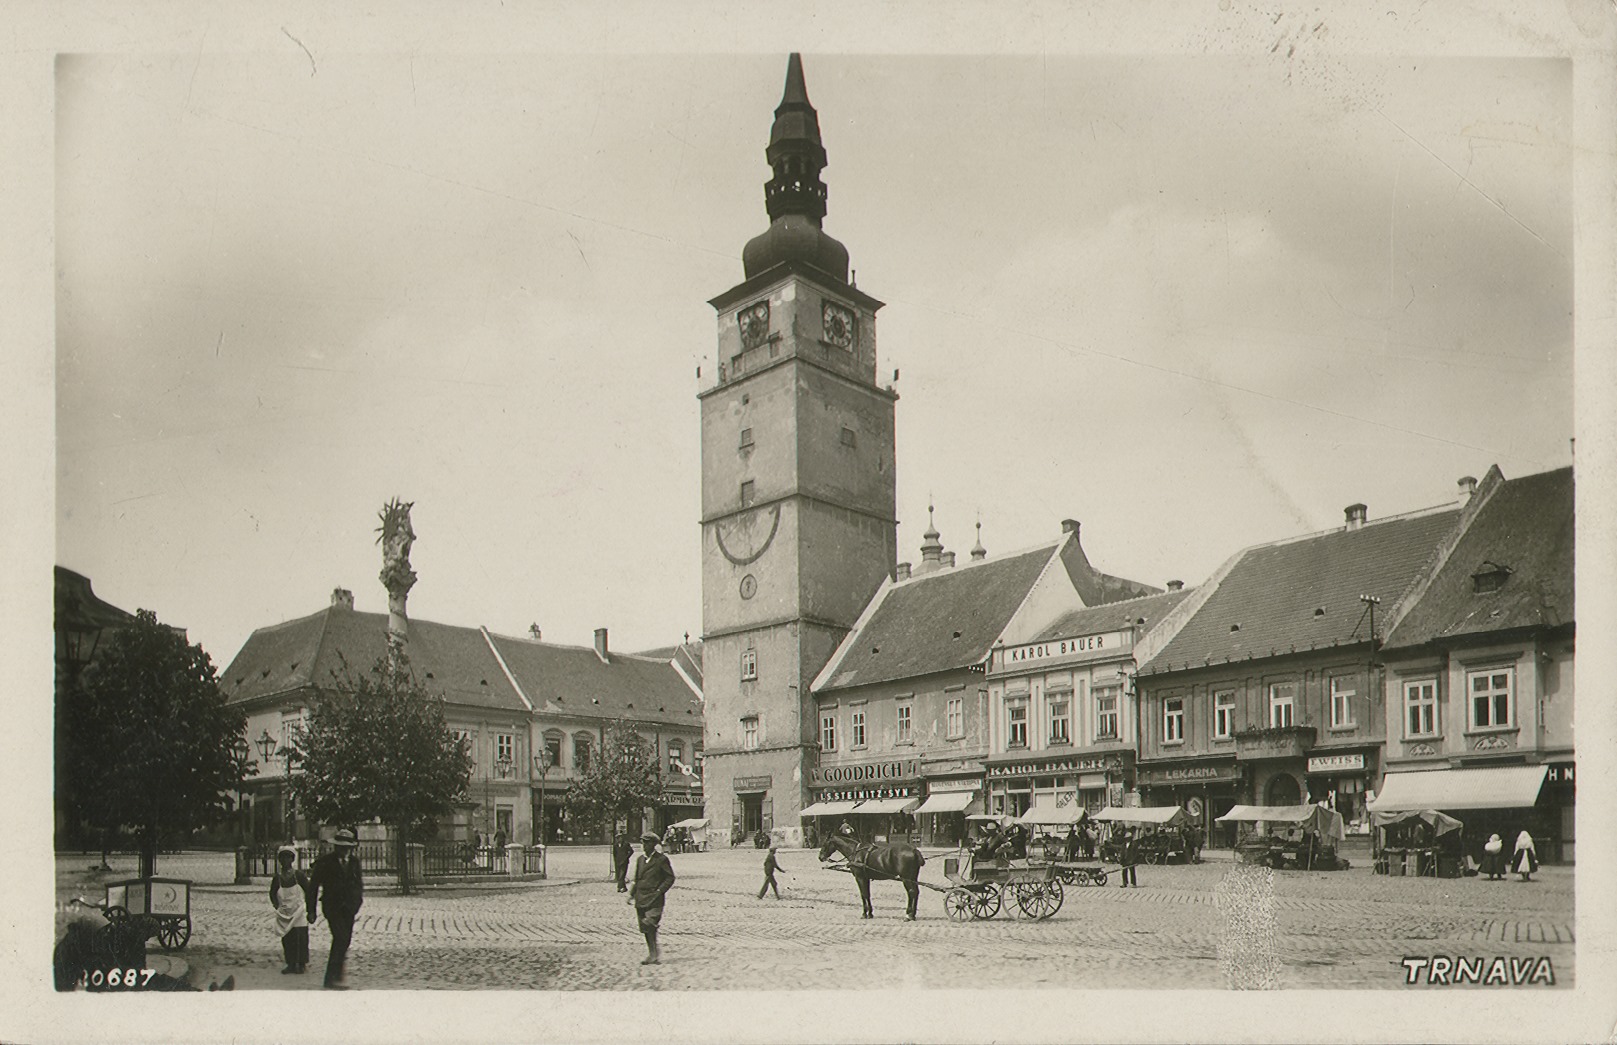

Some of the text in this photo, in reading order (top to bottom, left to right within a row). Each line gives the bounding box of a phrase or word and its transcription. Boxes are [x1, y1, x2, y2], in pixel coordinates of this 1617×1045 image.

[1012, 636, 1104, 662] KAROL BAUER
[823, 762, 903, 783] GOODRICH
[990, 758, 1104, 777] KAROL BAUER
